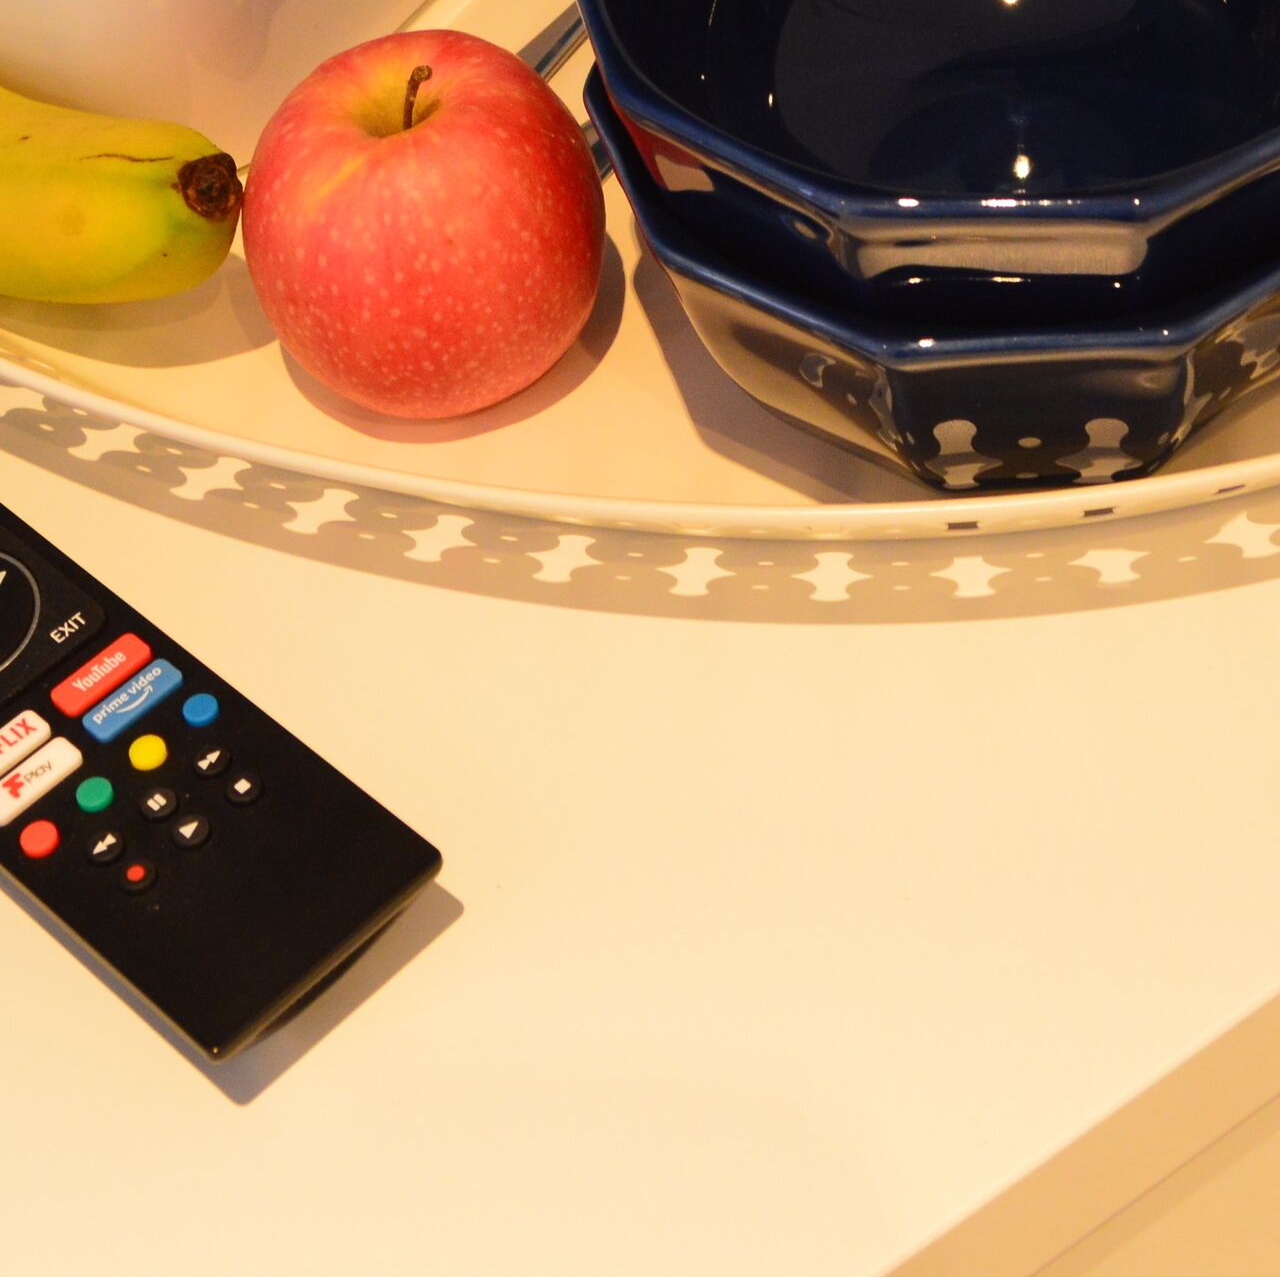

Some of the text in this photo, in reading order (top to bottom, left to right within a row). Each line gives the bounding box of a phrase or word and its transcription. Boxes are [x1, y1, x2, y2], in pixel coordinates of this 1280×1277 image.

[49, 611, 87, 644] EXIT
[71, 650, 127, 693] YouTube
[91, 666, 162, 725] prime video
